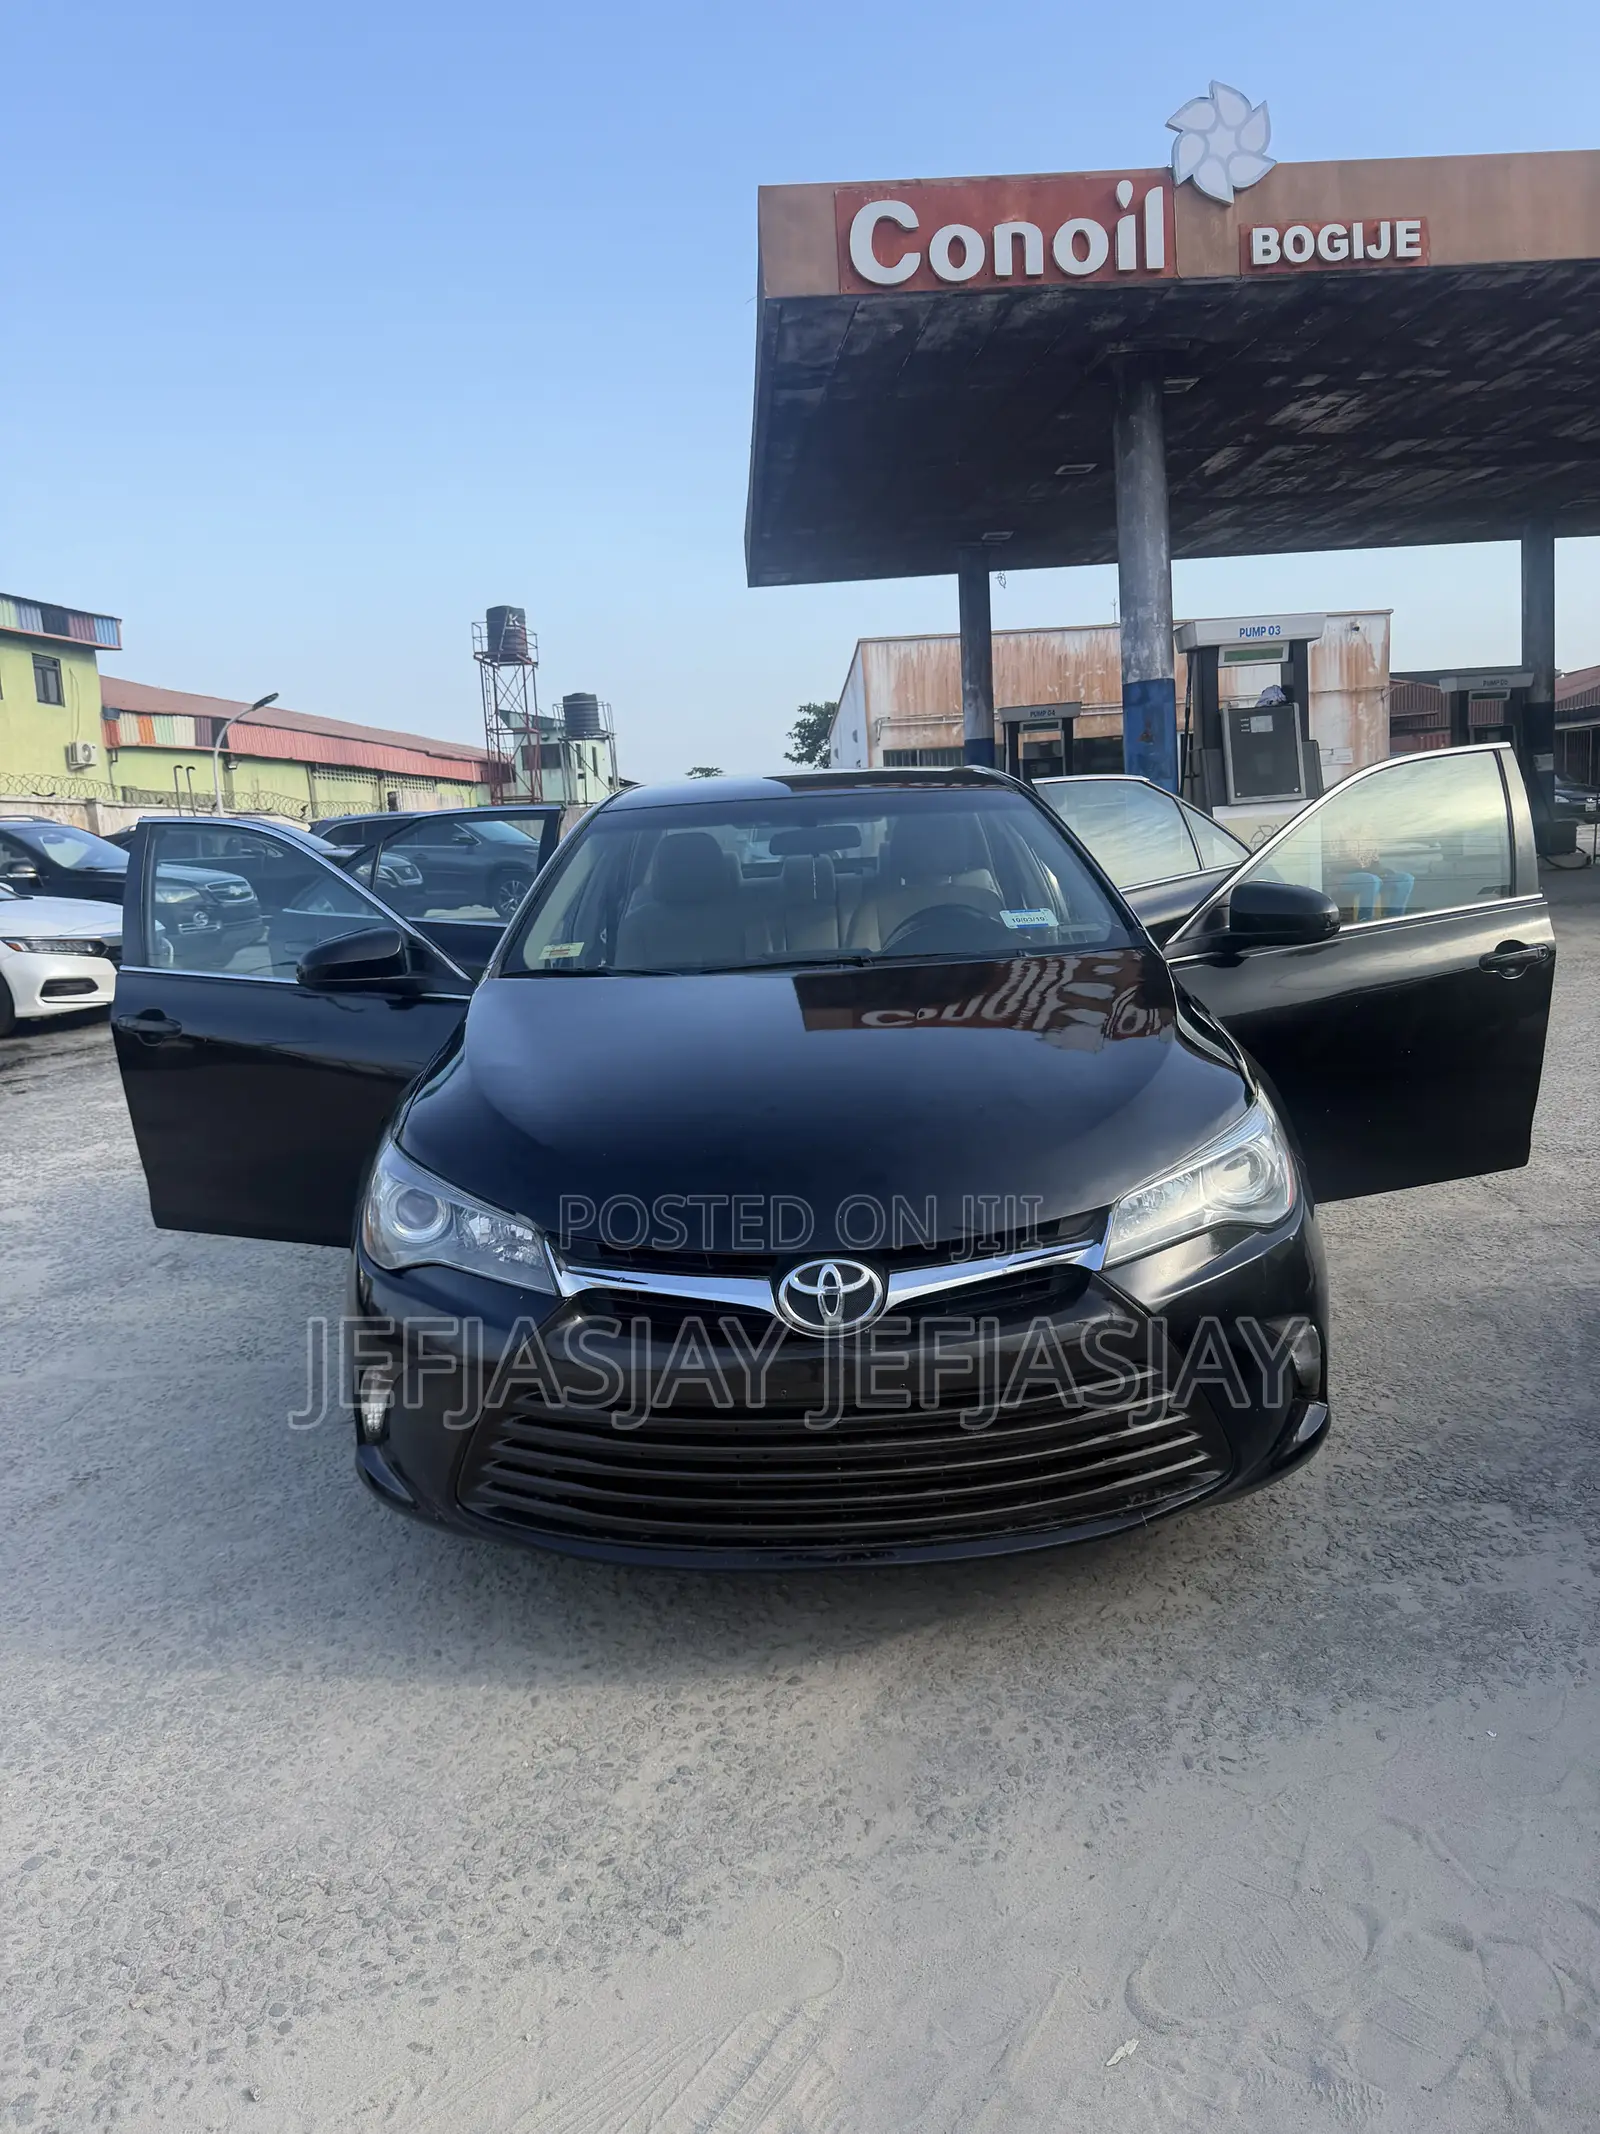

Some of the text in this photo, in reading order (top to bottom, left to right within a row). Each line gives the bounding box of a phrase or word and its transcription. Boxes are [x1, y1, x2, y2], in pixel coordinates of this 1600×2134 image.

[850, 180, 1165, 285] Conoil
[1251, 219, 1422, 266] BOGIJE
[1239, 625, 1281, 638] PUMP 03
